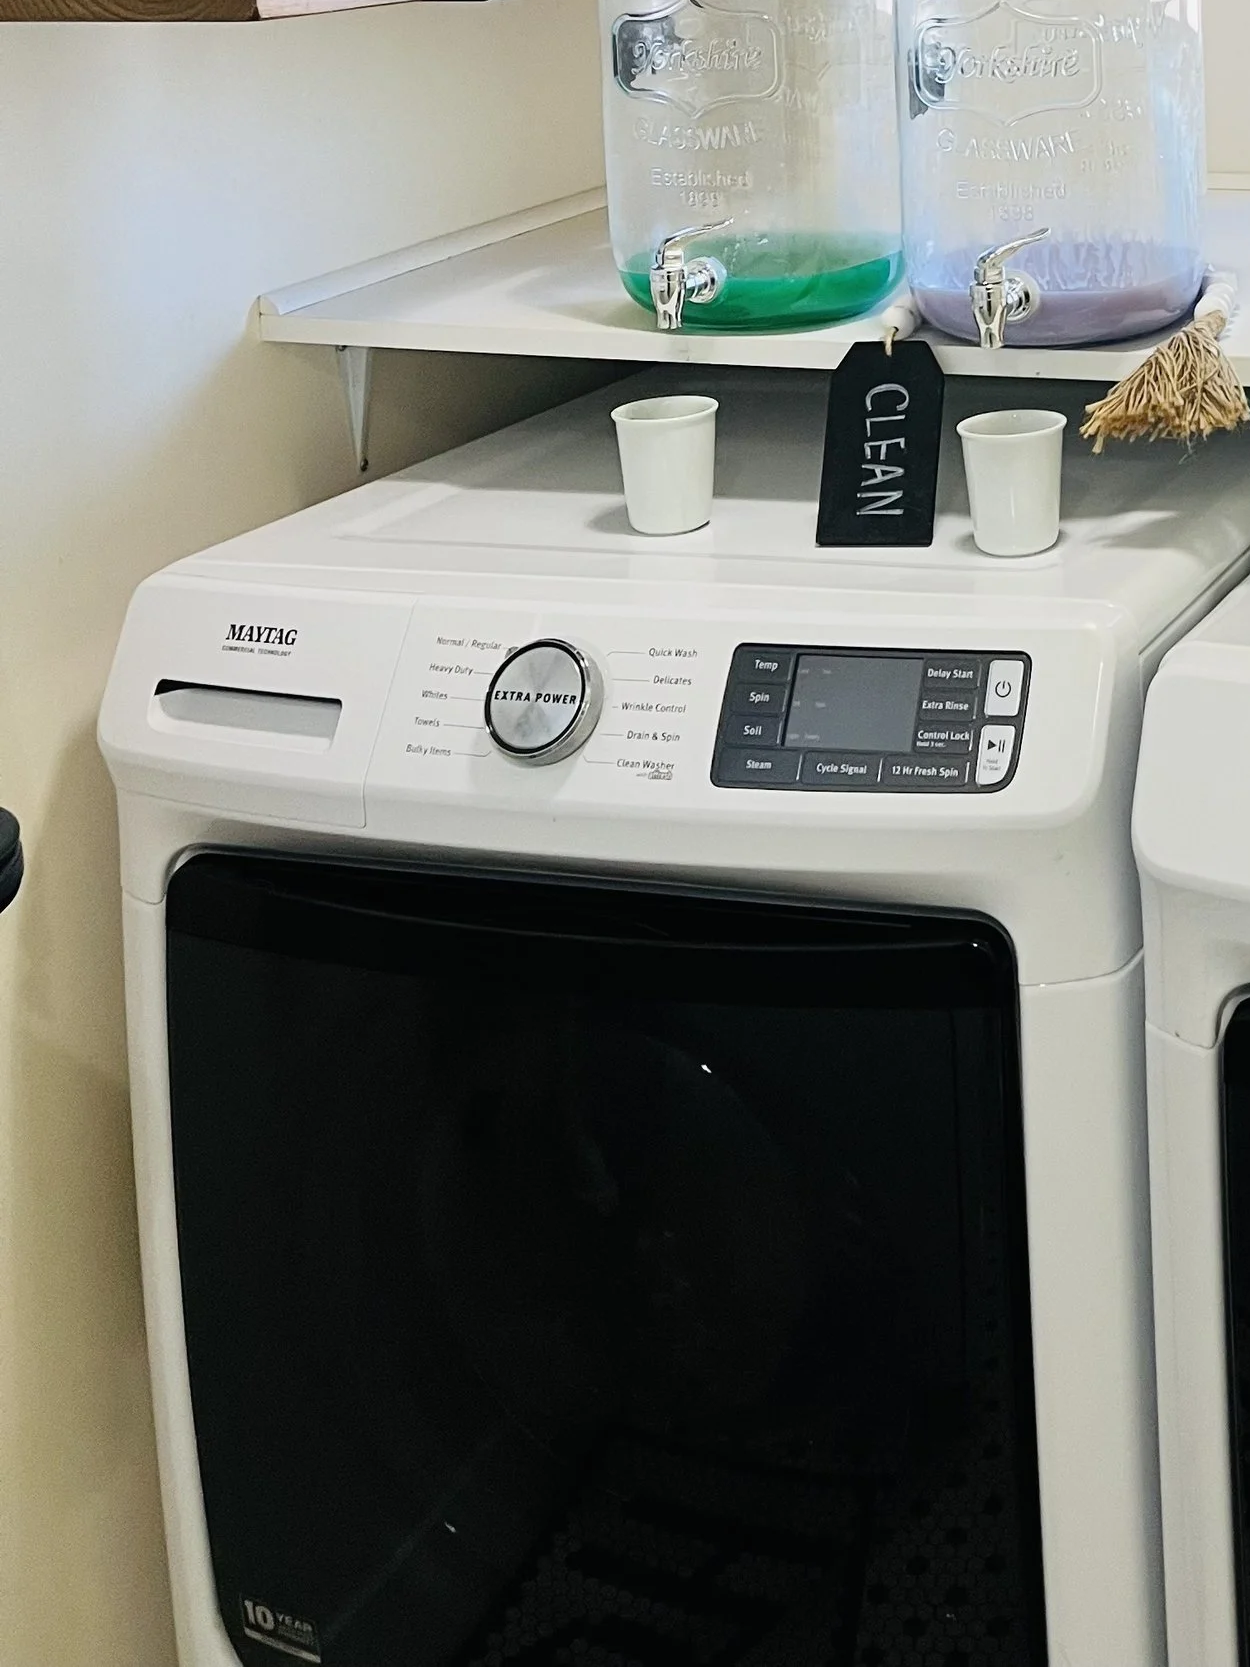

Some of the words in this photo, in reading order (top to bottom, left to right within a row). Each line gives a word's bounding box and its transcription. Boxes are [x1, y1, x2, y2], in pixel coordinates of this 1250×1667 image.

[630, 37, 762, 75] Yorkshire
[935, 45, 1080, 84] Yorkshire
[651, 167, 753, 188] Established
[856, 383, 910, 516] CLEAN
[225, 623, 298, 646] MAYTAG
[436, 636, 465, 647] Normal
[471, 638, 502, 651] Regular
[648, 647, 673, 658] Quick
[674, 648, 698, 659] Wash
[428, 662, 454, 675] Heavy
[454, 664, 473, 676] Duty
[755, 659, 779, 672] Temp
[653, 675, 692, 686] Delicates
[927, 668, 951, 680] Delay
[952, 669, 974, 680] Start
[421, 689, 448, 700] Whites
[494, 690, 531, 703] EXTRA
[535, 692, 577, 705] POWER
[749, 691, 770, 704] Spin
[621, 701, 654, 712] Wrinkle
[655, 703, 687, 714] Control
[922, 700, 944, 710] Extra
[945, 701, 969, 711] Rinse
[414, 716, 440, 727] Towels
[627, 730, 650, 740] Drain
[651, 732, 658, 741] &
[660, 732, 681, 742] Spin
[743, 725, 762, 736] Soil
[917, 730, 949, 740] Control
[950, 731, 970, 741] Lock
[405, 743, 428, 755] Bulky
[429, 746, 452, 756] Items
[616, 758, 641, 769] Clean
[642, 760, 675, 770] Washer
[745, 759, 772, 769] Steam
[816, 762, 839, 774] Cycle
[839, 764, 867, 775] Signal
[892, 765, 901, 775] 12
[902, 767, 913, 776] Hr
[913, 767, 937, 777] Fresh
[938, 768, 959, 779] Spin
[244, 1599, 276, 1631] 10
